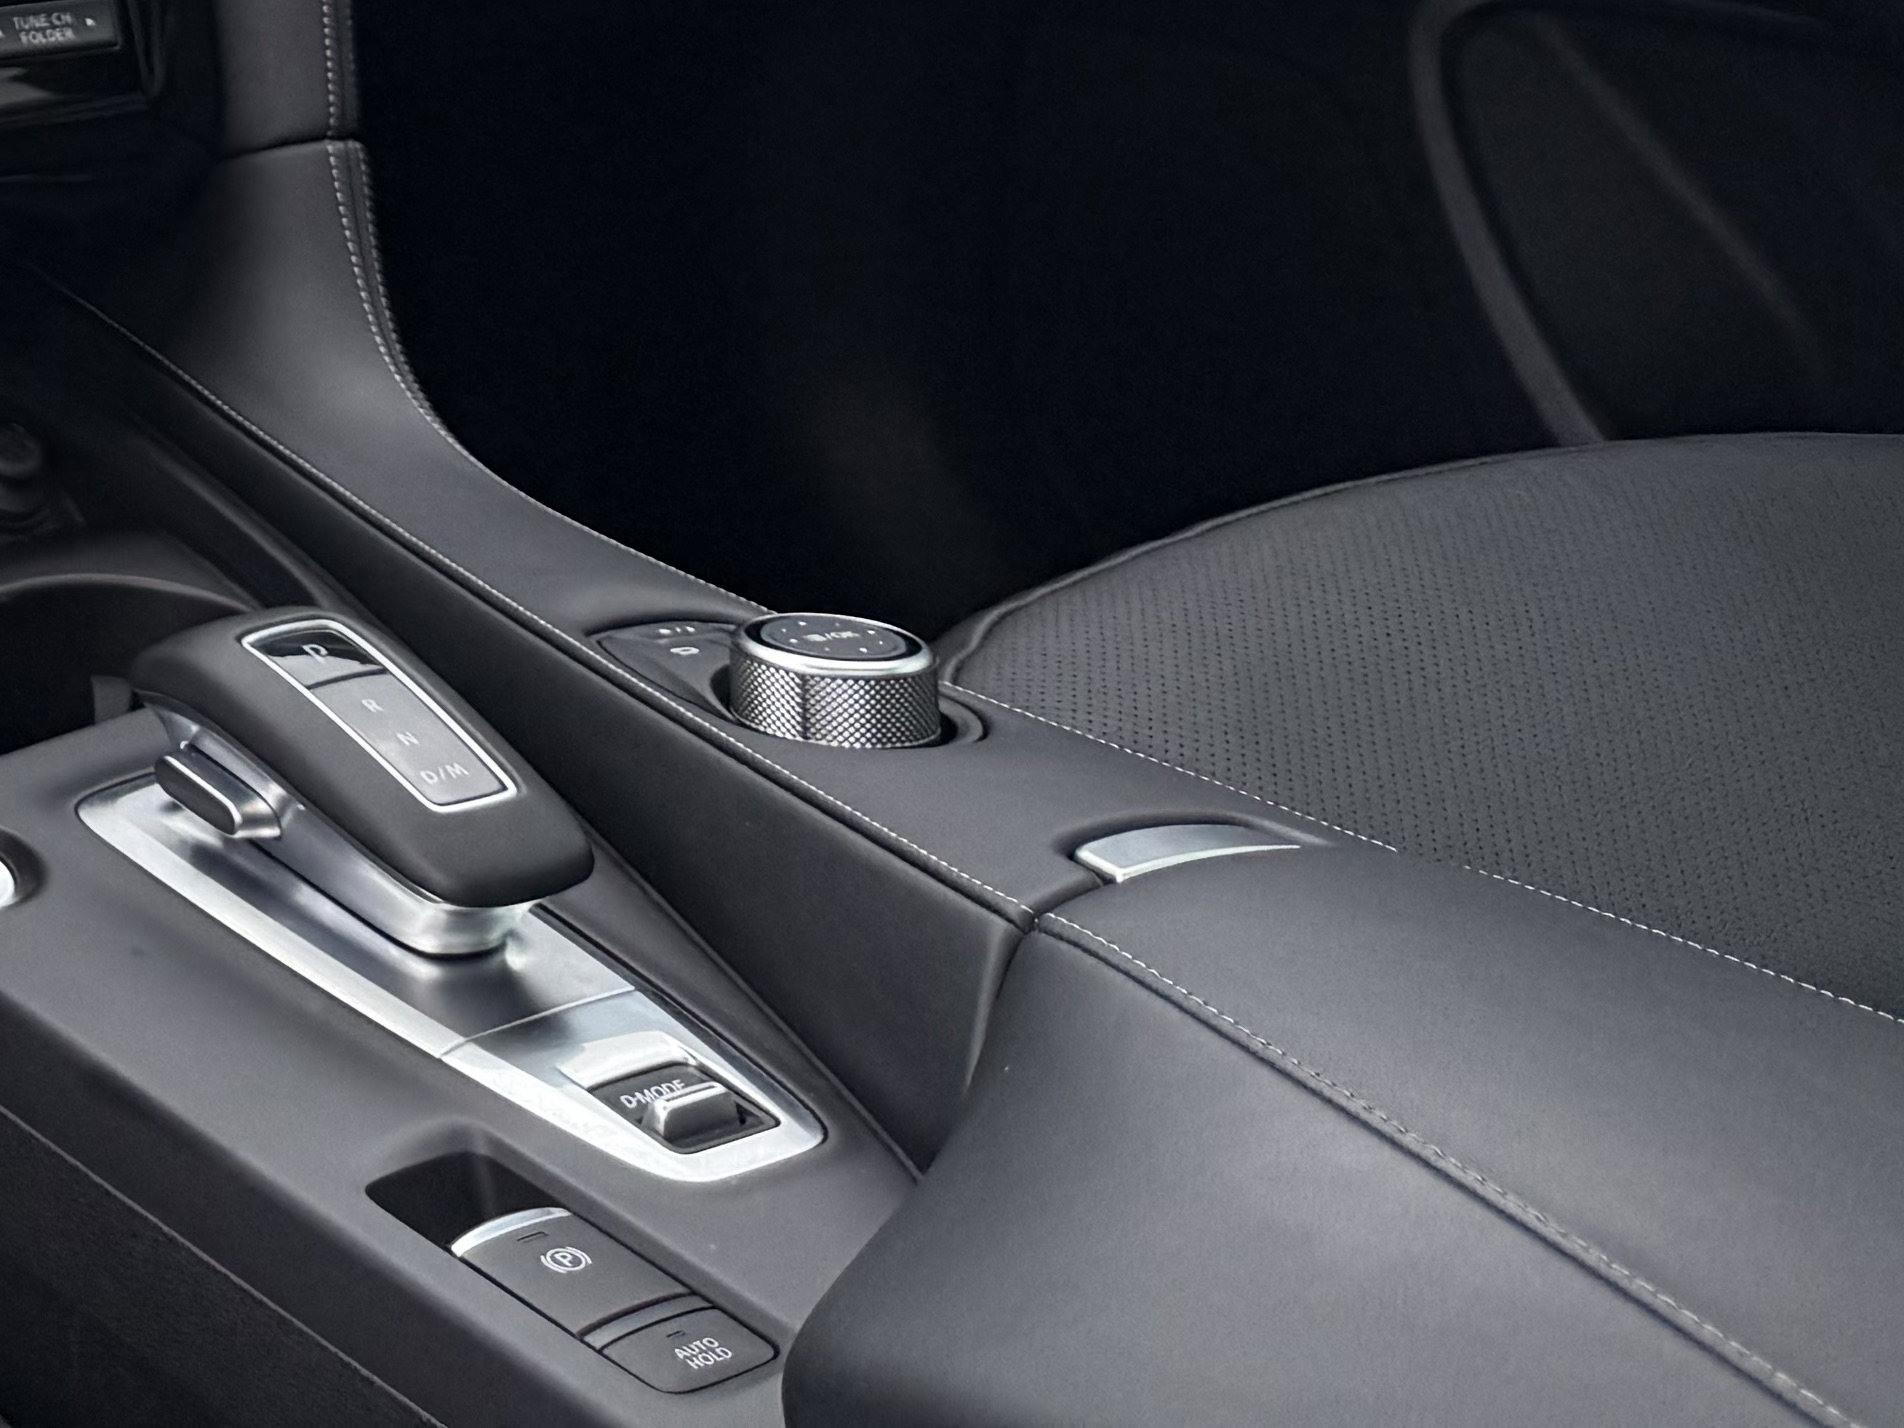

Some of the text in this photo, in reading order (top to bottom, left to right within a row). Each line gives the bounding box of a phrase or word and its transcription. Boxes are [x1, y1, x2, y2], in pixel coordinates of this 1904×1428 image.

[19, 27, 76, 45] FOLDER
[302, 644, 329, 664] P
[361, 698, 384, 713] R
[396, 730, 420, 746] N
[674, 1337, 720, 1360] AUTO
[684, 1347, 733, 1370] HOLD
